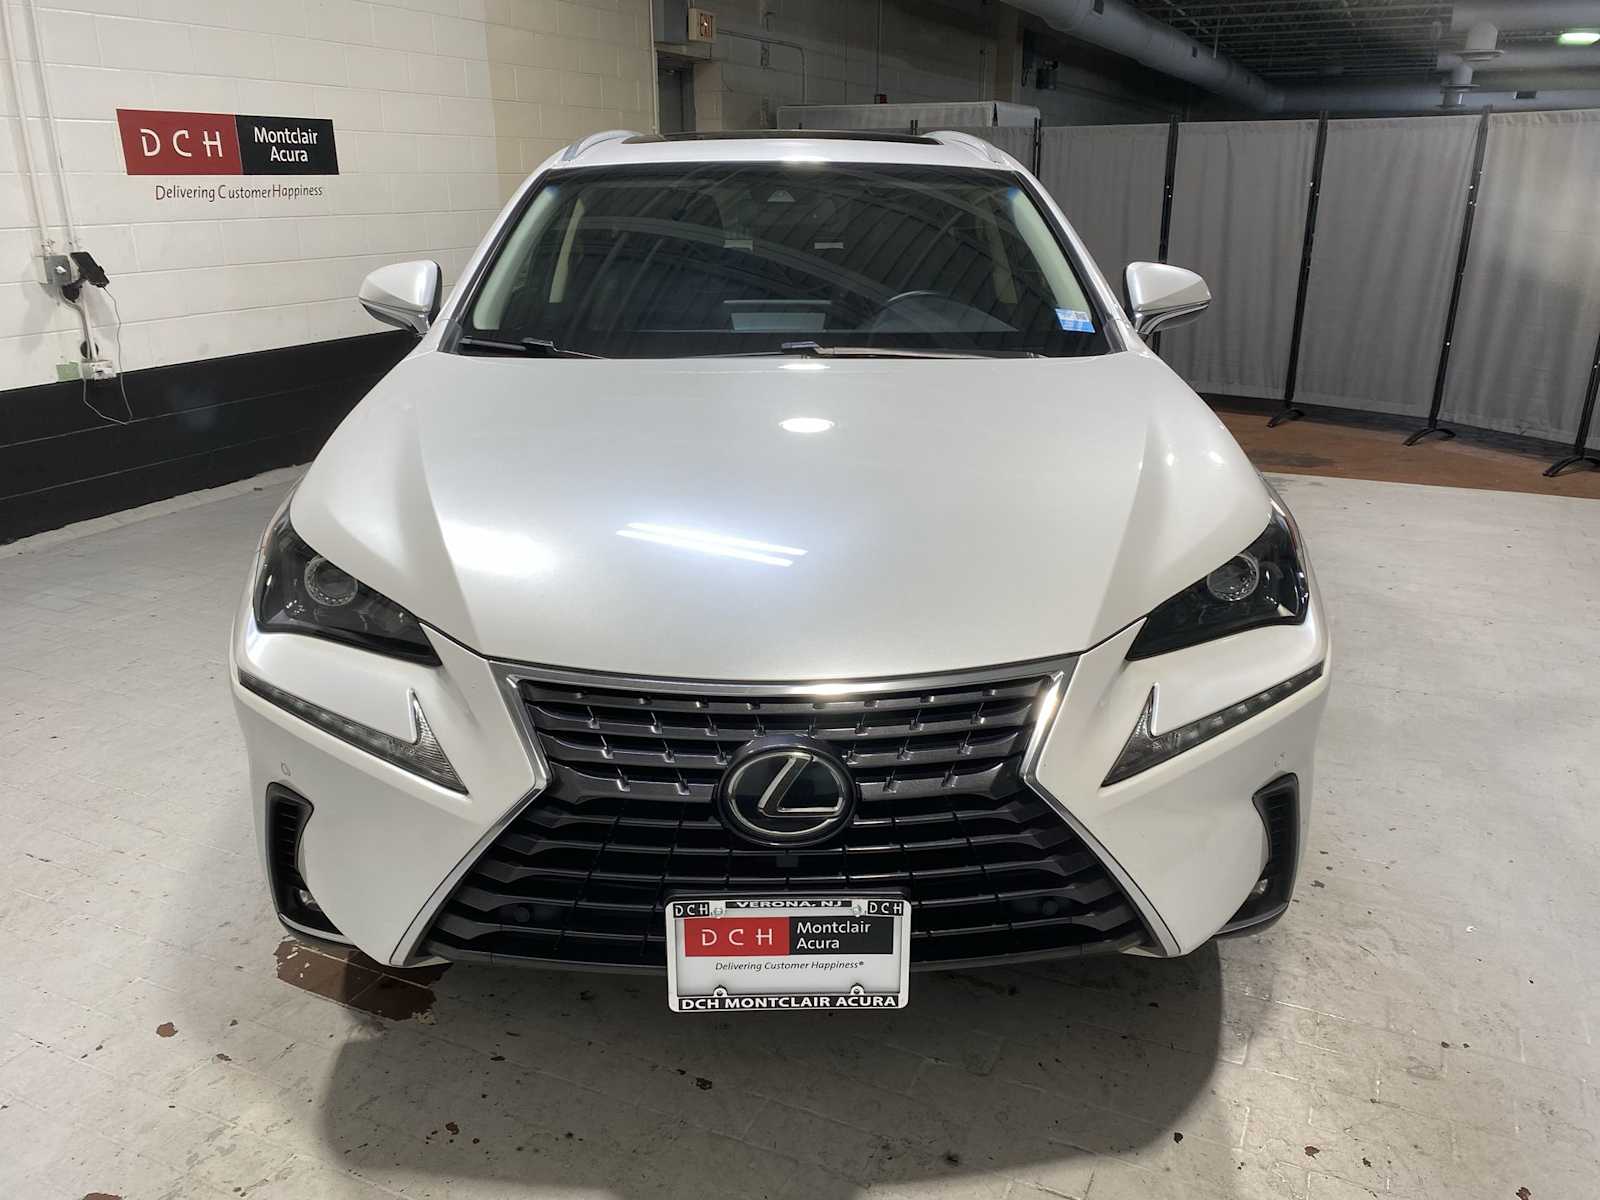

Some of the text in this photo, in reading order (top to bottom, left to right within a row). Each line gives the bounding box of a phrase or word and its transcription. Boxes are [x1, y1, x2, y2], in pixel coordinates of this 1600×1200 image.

[254, 126, 319, 145] Montclair
[140, 128, 223, 158] DCH
[270, 146, 309, 163] Acura
[155, 184, 323, 202] Delivering Customer Happiness
[675, 904, 709, 916] DCH
[737, 900, 816, 908] VERONA,
[869, 902, 903, 914] DCH
[797, 921, 871, 934] Montclair
[701, 928, 773, 946] DCH
[796, 937, 840, 950] Acura
[715, 961, 762, 971] Delivering
[764, 961, 809, 970] Customer
[681, 995, 896, 1010] DCH MONTCLAIR ACURA
